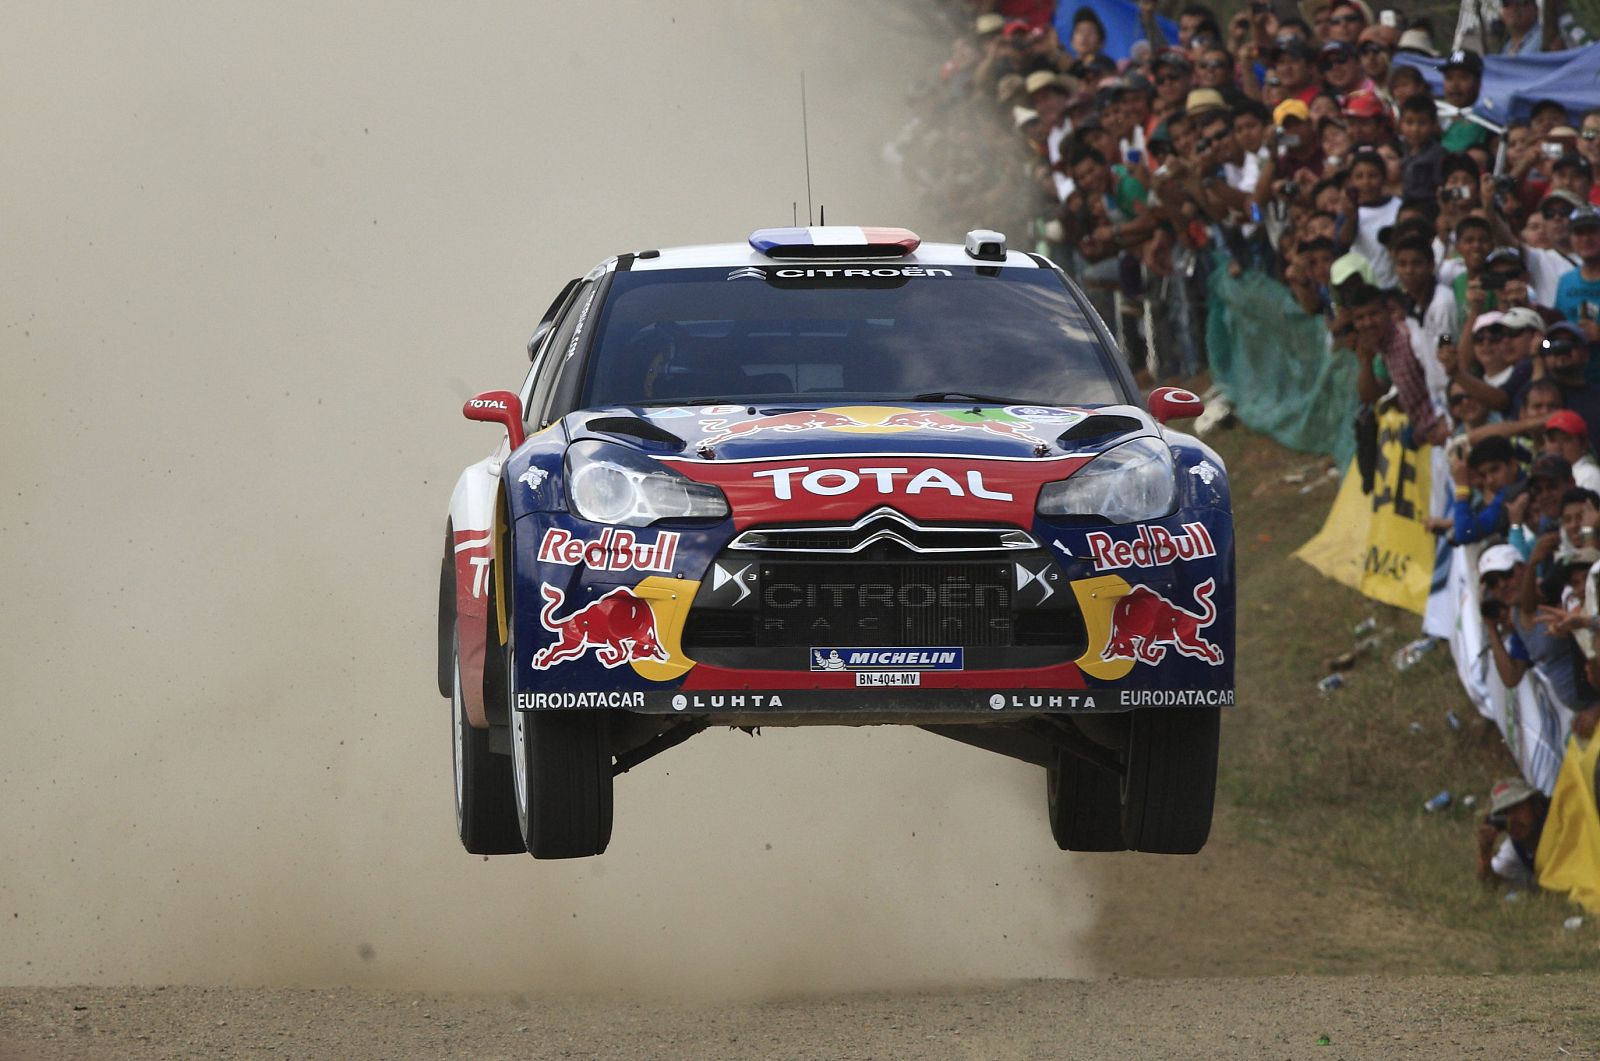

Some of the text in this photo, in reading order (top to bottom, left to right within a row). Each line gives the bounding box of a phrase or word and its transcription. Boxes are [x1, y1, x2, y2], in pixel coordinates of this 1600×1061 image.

[470, 398, 508, 410] TOTAL
[753, 465, 1013, 502] TOTAL
[849, 652, 956, 664] MICHELIN
[859, 673, 917, 685] BN-404-MV
[517, 691, 645, 709] EURODATACAR
[693, 695, 783, 708] LUHTA
[1012, 695, 1096, 708] LUHTA
[1120, 690, 1235, 706] EURODATACAR
